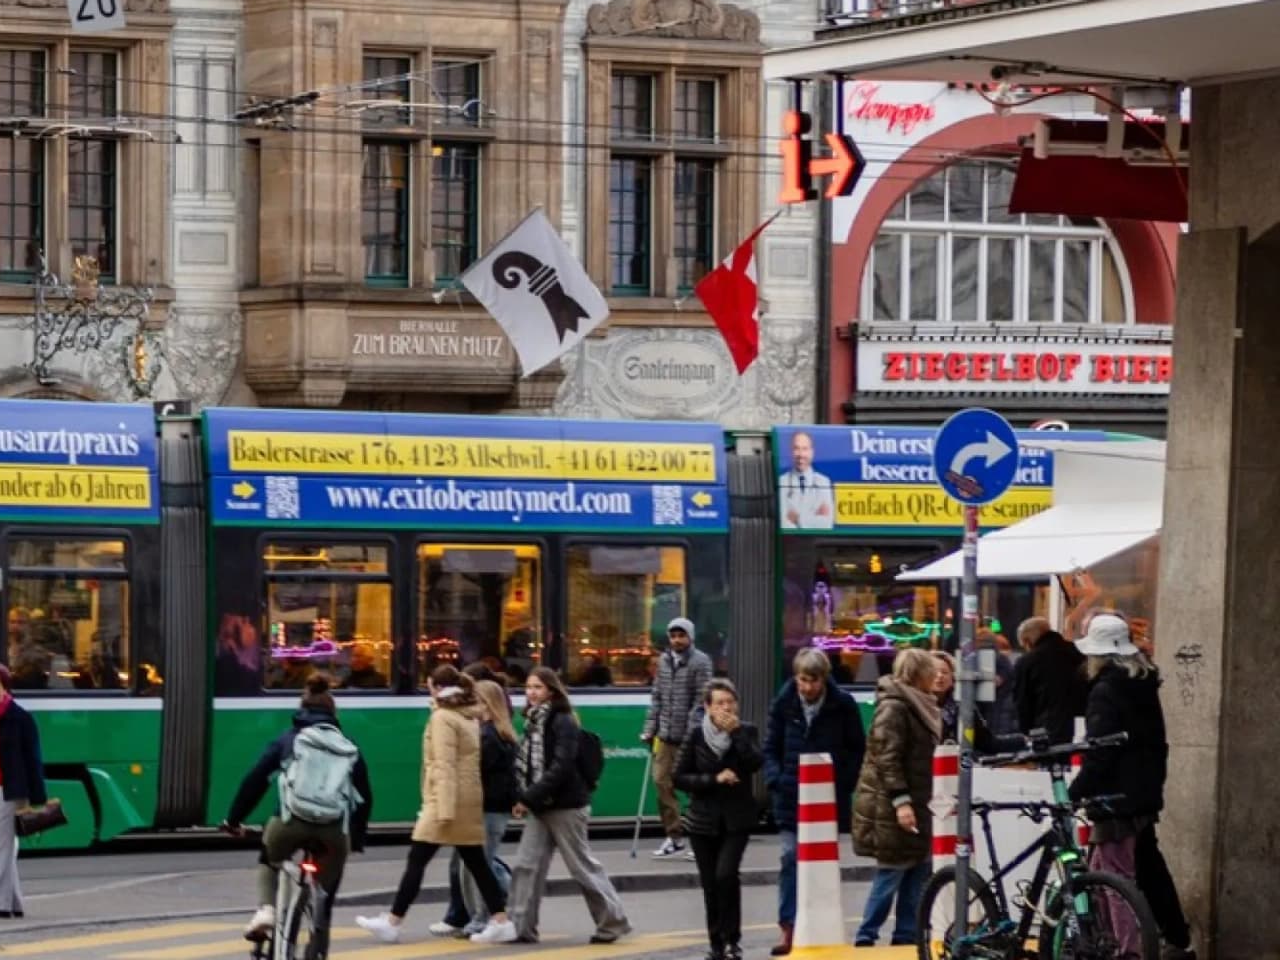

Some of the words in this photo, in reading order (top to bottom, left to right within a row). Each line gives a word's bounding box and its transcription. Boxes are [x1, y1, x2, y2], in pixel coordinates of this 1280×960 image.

[352, 334, 385, 355] ZUM
[389, 335, 459, 356] BRAUNEN
[462, 336, 504, 357] MUTZ
[882, 352, 1081, 382] ZIEGELHOF
[231, 436, 355, 465] Baslerstrasse
[361, 441, 404, 466] 176,
[409, 443, 459, 467] 4123
[465, 443, 552, 470] Allschwil,
[595, 449, 617, 471] 61
[625, 449, 658, 472] 422
[662, 450, 686, 473] 00
[689, 450, 711, 473] 77
[851, 428, 897, 455] Dein
[44, 474, 68, 498] ab
[70, 477, 82, 499] 6
[85, 477, 147, 502] Jahren
[326, 478, 632, 523] www.exitobeautymed.com
[837, 492, 903, 515] einfach
